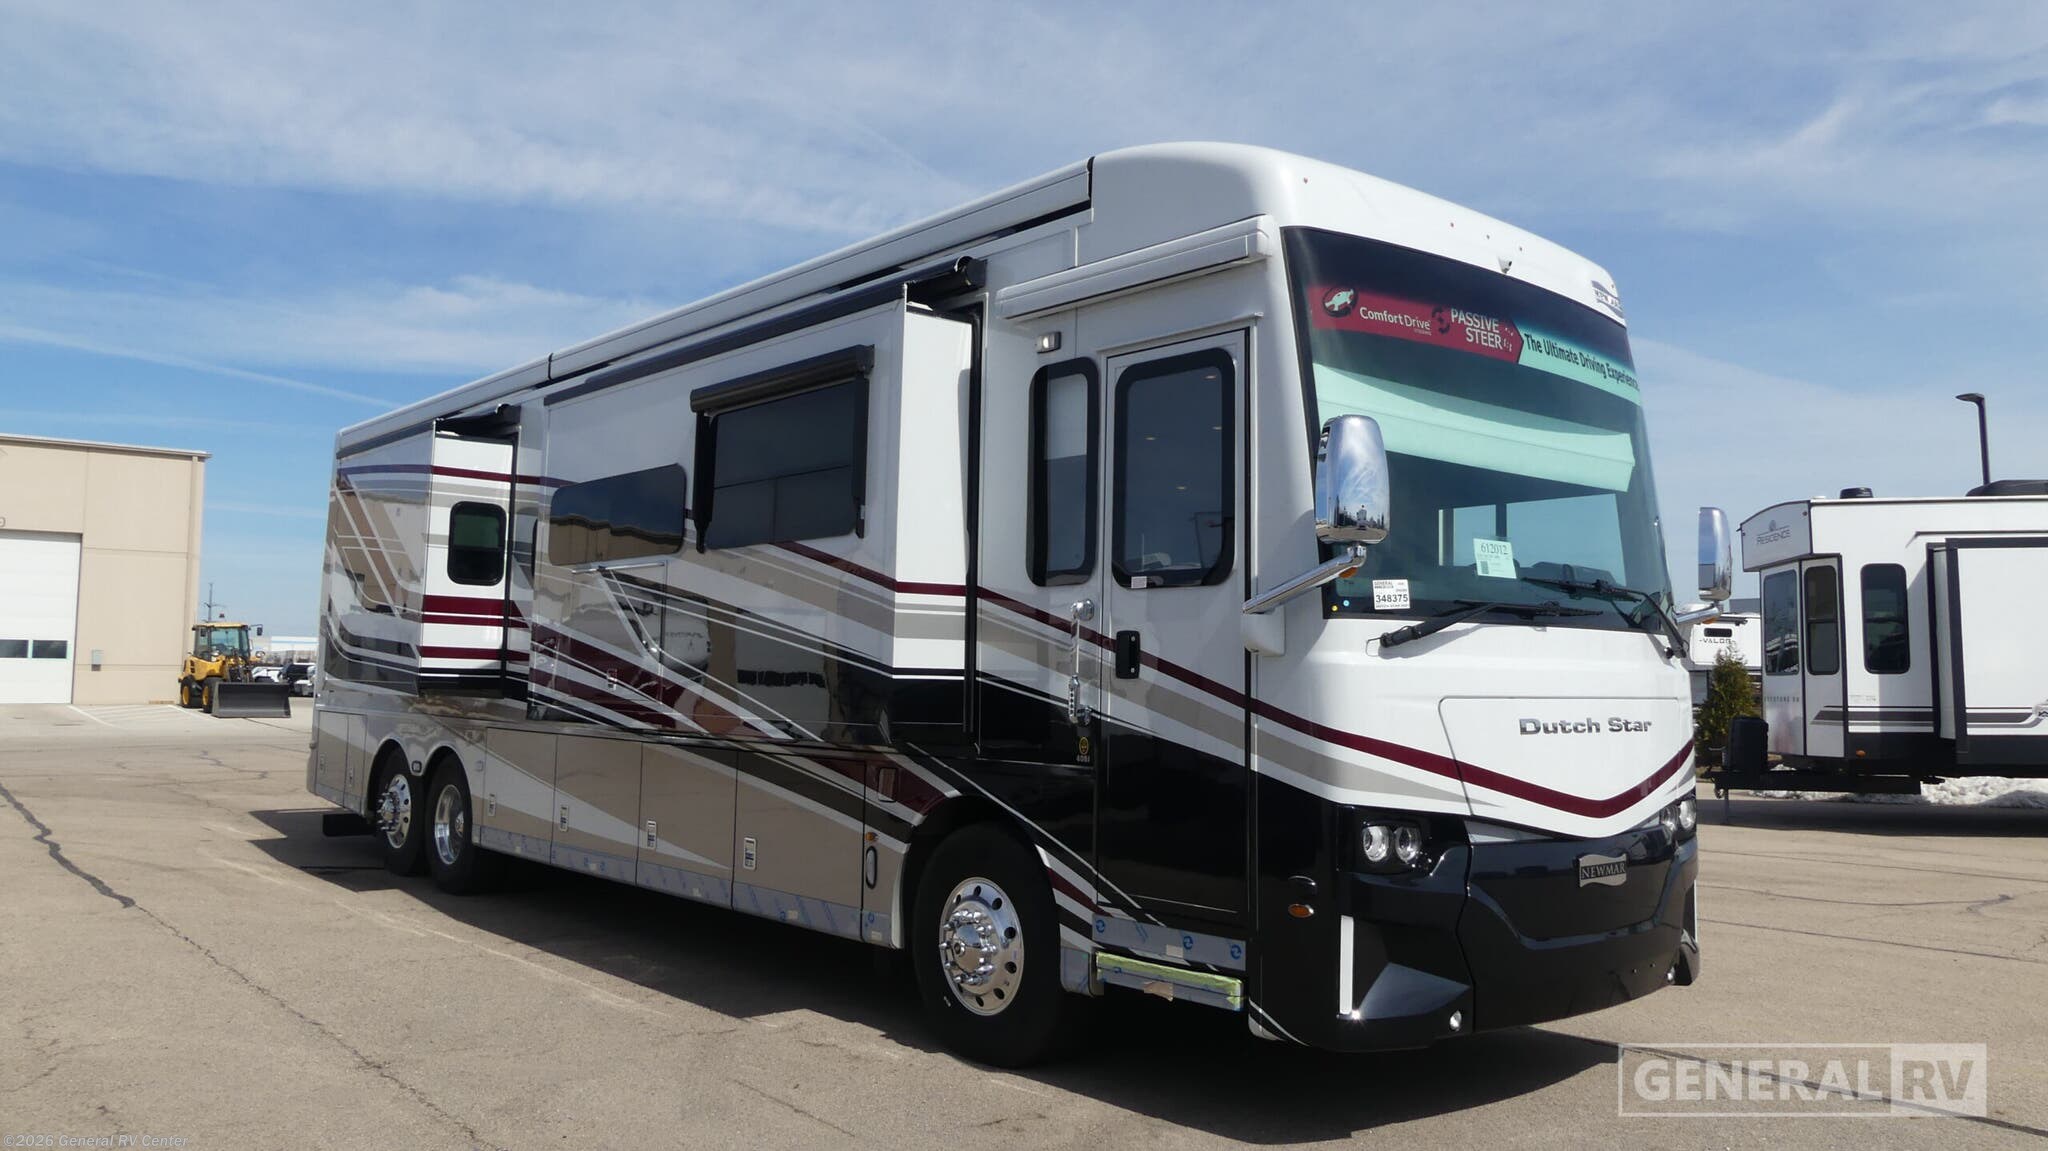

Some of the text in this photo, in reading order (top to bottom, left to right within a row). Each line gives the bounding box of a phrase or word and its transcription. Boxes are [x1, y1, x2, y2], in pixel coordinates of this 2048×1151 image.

[1450, 307, 1500, 333] PASSIVE
[1465, 327, 1503, 350] STEER
[1524, 333, 1543, 353] The
[1543, 338, 1580, 365] Ultimate
[1579, 352, 1608, 379] Driving
[1480, 543, 1509, 555] 612012
[1375, 594, 1409, 603] 348375
[1519, 717, 1653, 736] Dutch Star
[1581, 862, 1626, 880] NEWMAR
